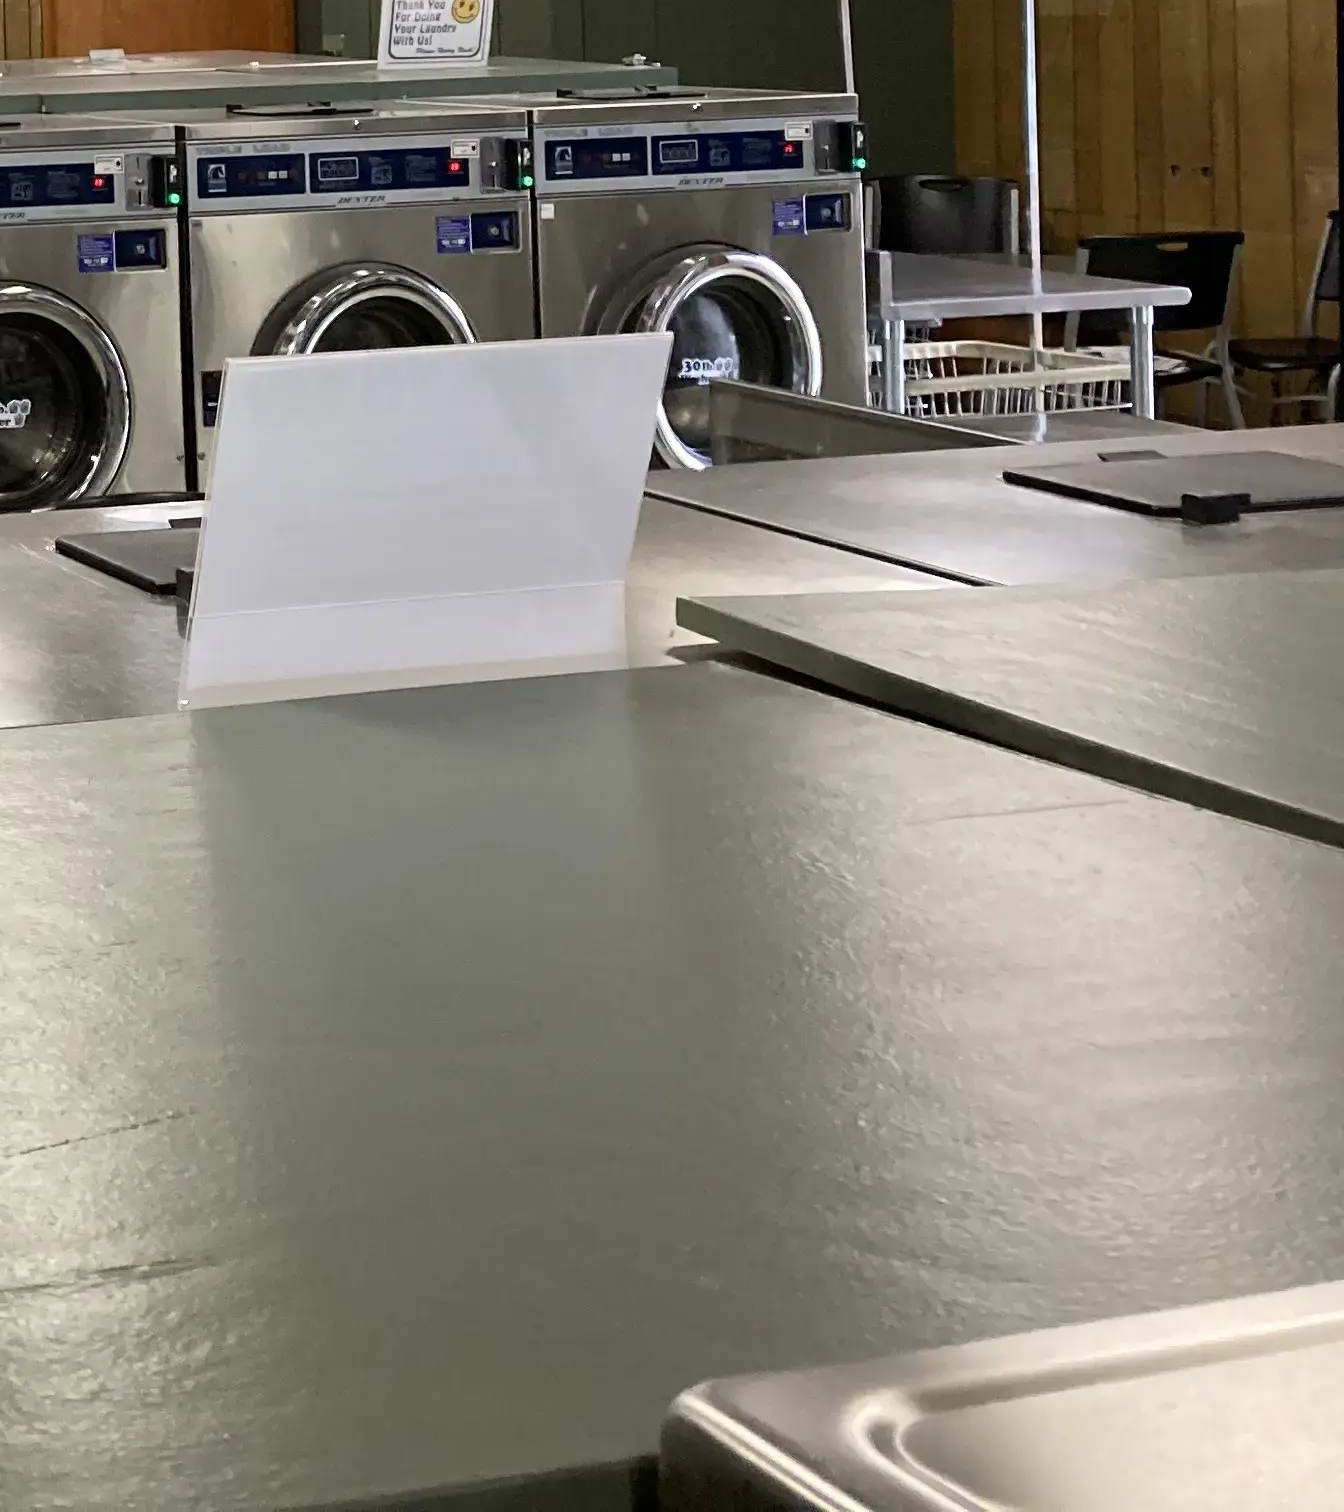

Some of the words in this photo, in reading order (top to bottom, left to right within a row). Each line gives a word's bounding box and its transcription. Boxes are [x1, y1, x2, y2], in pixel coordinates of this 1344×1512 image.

[396, 0, 424, 10] Thank
[428, 0, 446, 10] You
[395, 13, 412, 22] For
[414, 12, 441, 22] Doing
[394, 24, 416, 34] Your
[419, 24, 457, 34] Laundry
[393, 36, 414, 46] With
[683, 360, 701, 373] 30
